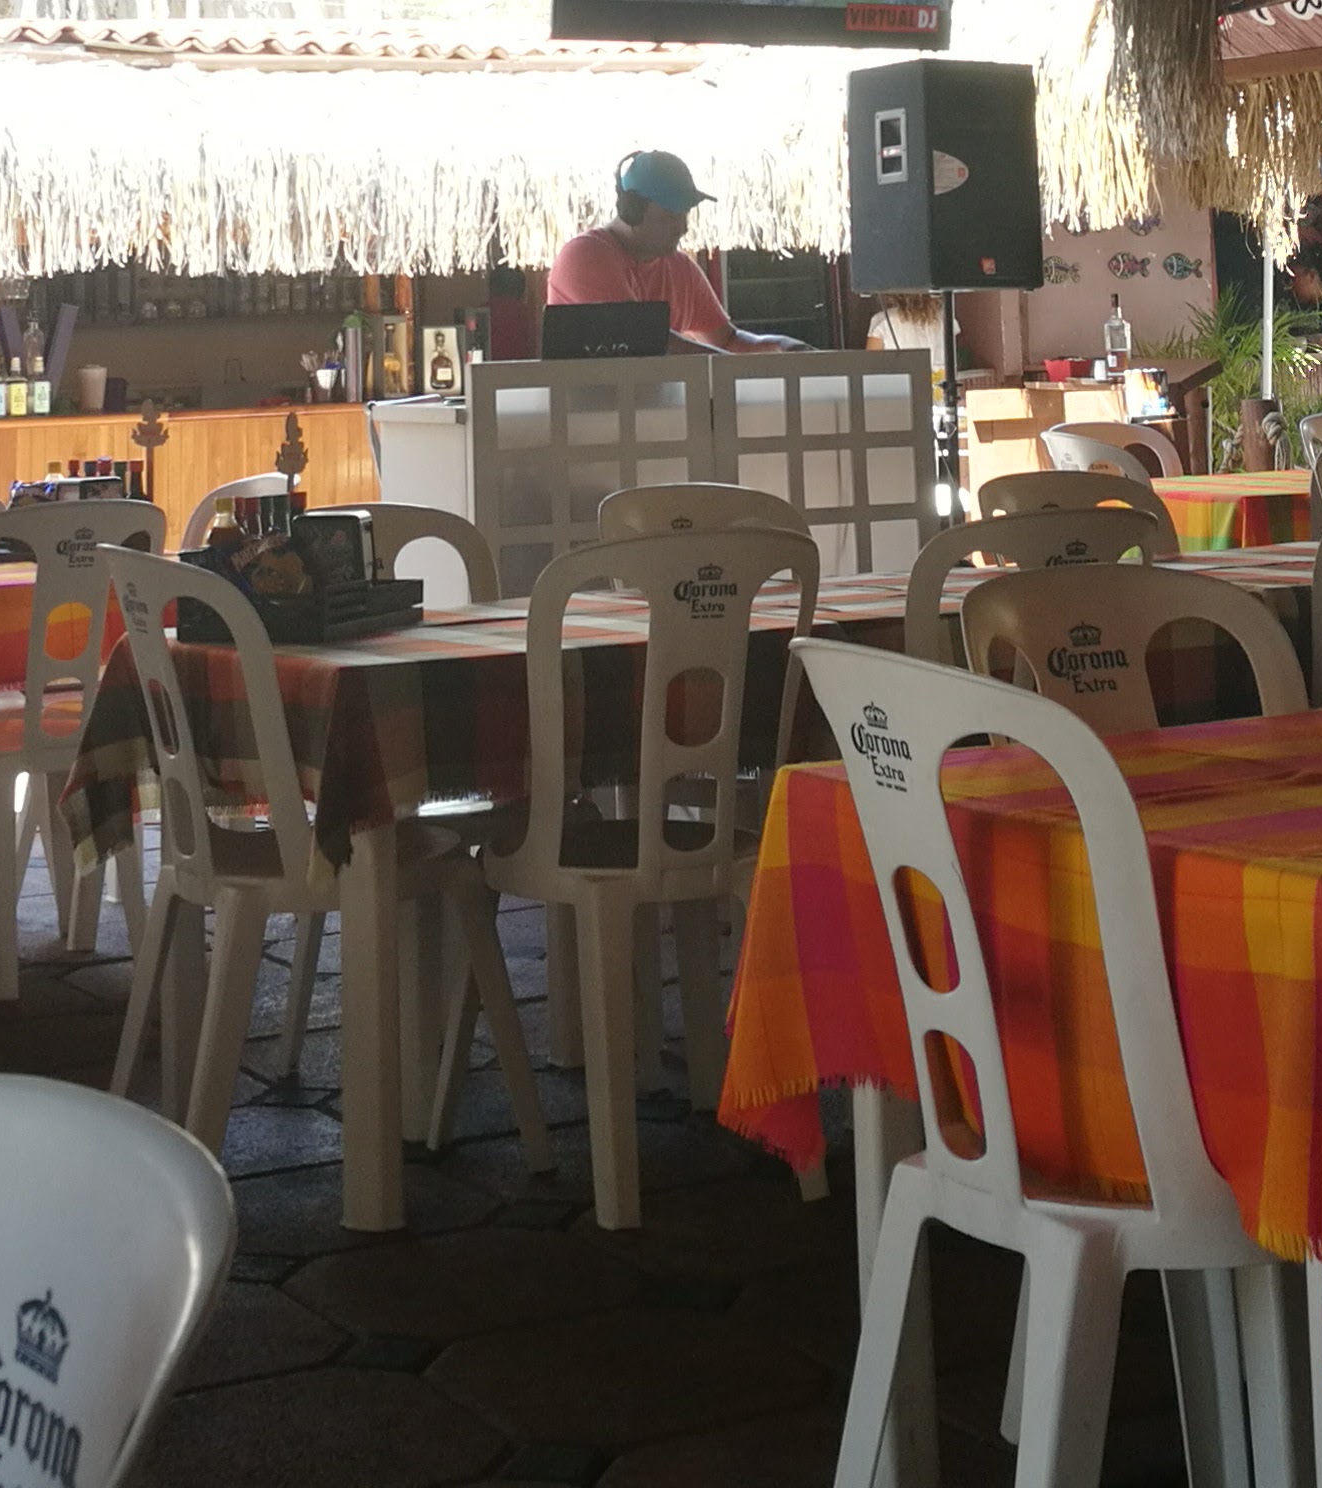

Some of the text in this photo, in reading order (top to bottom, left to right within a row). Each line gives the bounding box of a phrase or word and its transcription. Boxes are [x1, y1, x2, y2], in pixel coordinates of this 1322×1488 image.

[848, 7, 938, 29] VIRTUALDJ
[56, 538, 98, 556] Coron
[674, 580, 738, 604] Corona
[691, 598, 726, 614] Extra
[1047, 647, 1130, 680] Corona
[1072, 673, 1118, 694] Extra
[851, 722, 913, 761] Corona
[871, 755, 906, 783] Extra
